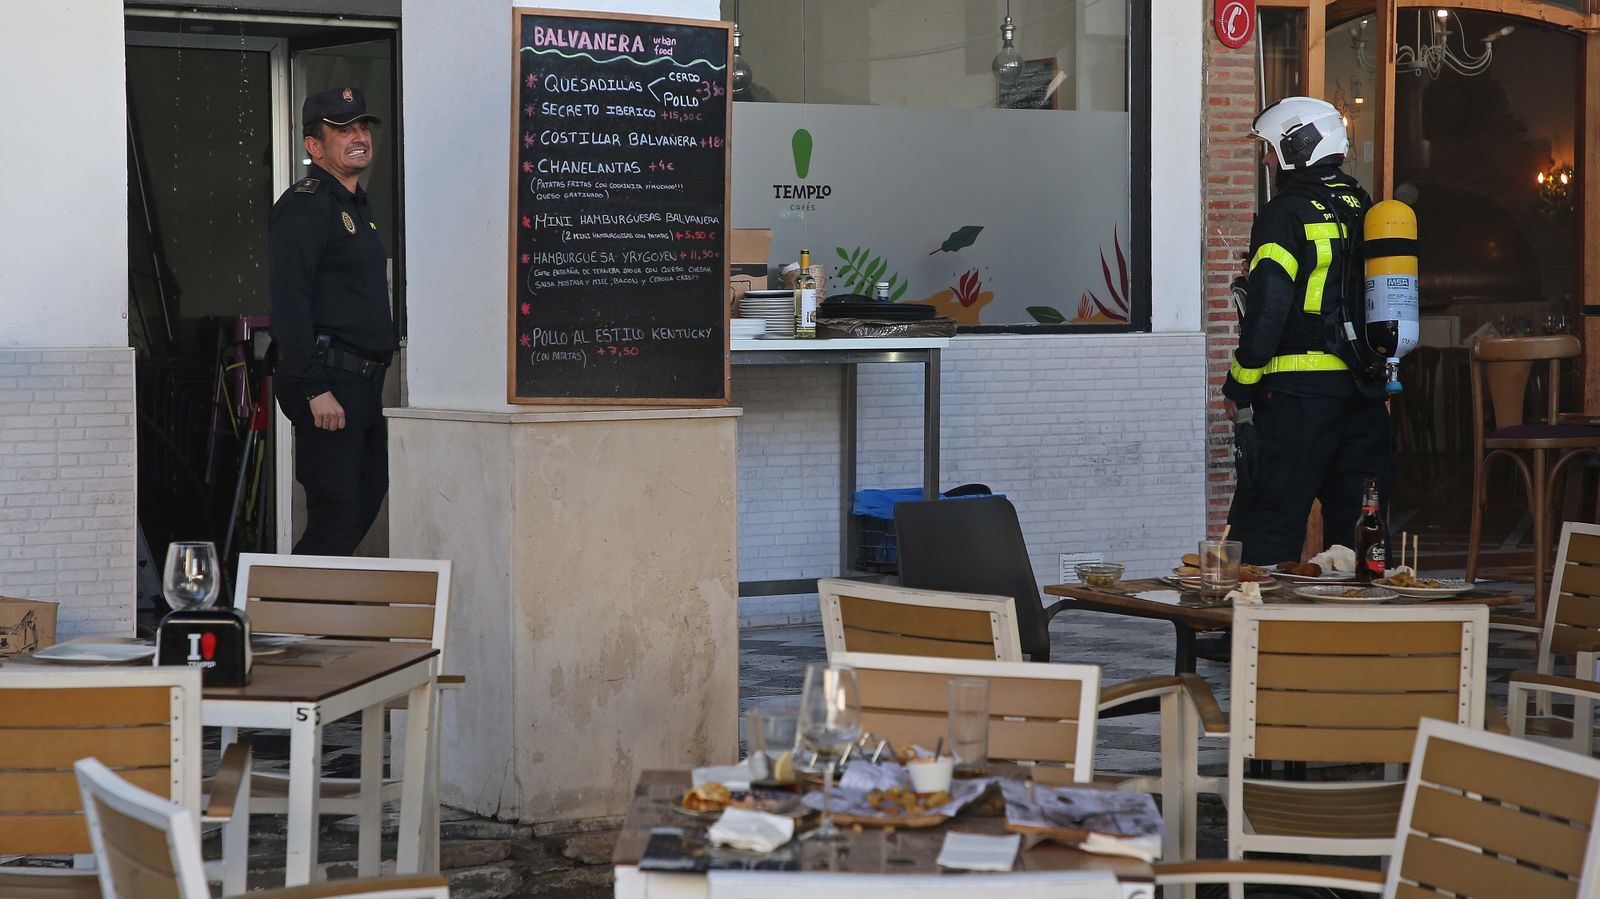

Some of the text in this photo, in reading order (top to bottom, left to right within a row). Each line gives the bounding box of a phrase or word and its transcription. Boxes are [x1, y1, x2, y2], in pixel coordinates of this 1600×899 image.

[534, 26, 644, 53] BALVANERA
[653, 36, 677, 45] urban
[654, 46, 673, 56] food
[545, 74, 643, 93] QUESADILLAS
[669, 72, 700, 83] CERDO
[664, 92, 698, 107] POLLO
[542, 102, 599, 116] SECRETO
[606, 106, 656, 118] IBERICO
[541, 131, 620, 146] COSTILLAR
[629, 133, 697, 147] BALVANERA
[538, 159, 641, 173] CHANELANTAS
[773, 185, 831, 199] TEMPLO
[790, 202, 815, 211] CAFÉS
[535, 213, 719, 230] MINI HAMBURGUESAS BALVANERA
[532, 328, 712, 347] POLLO AL ESTILO KENTUCKY
